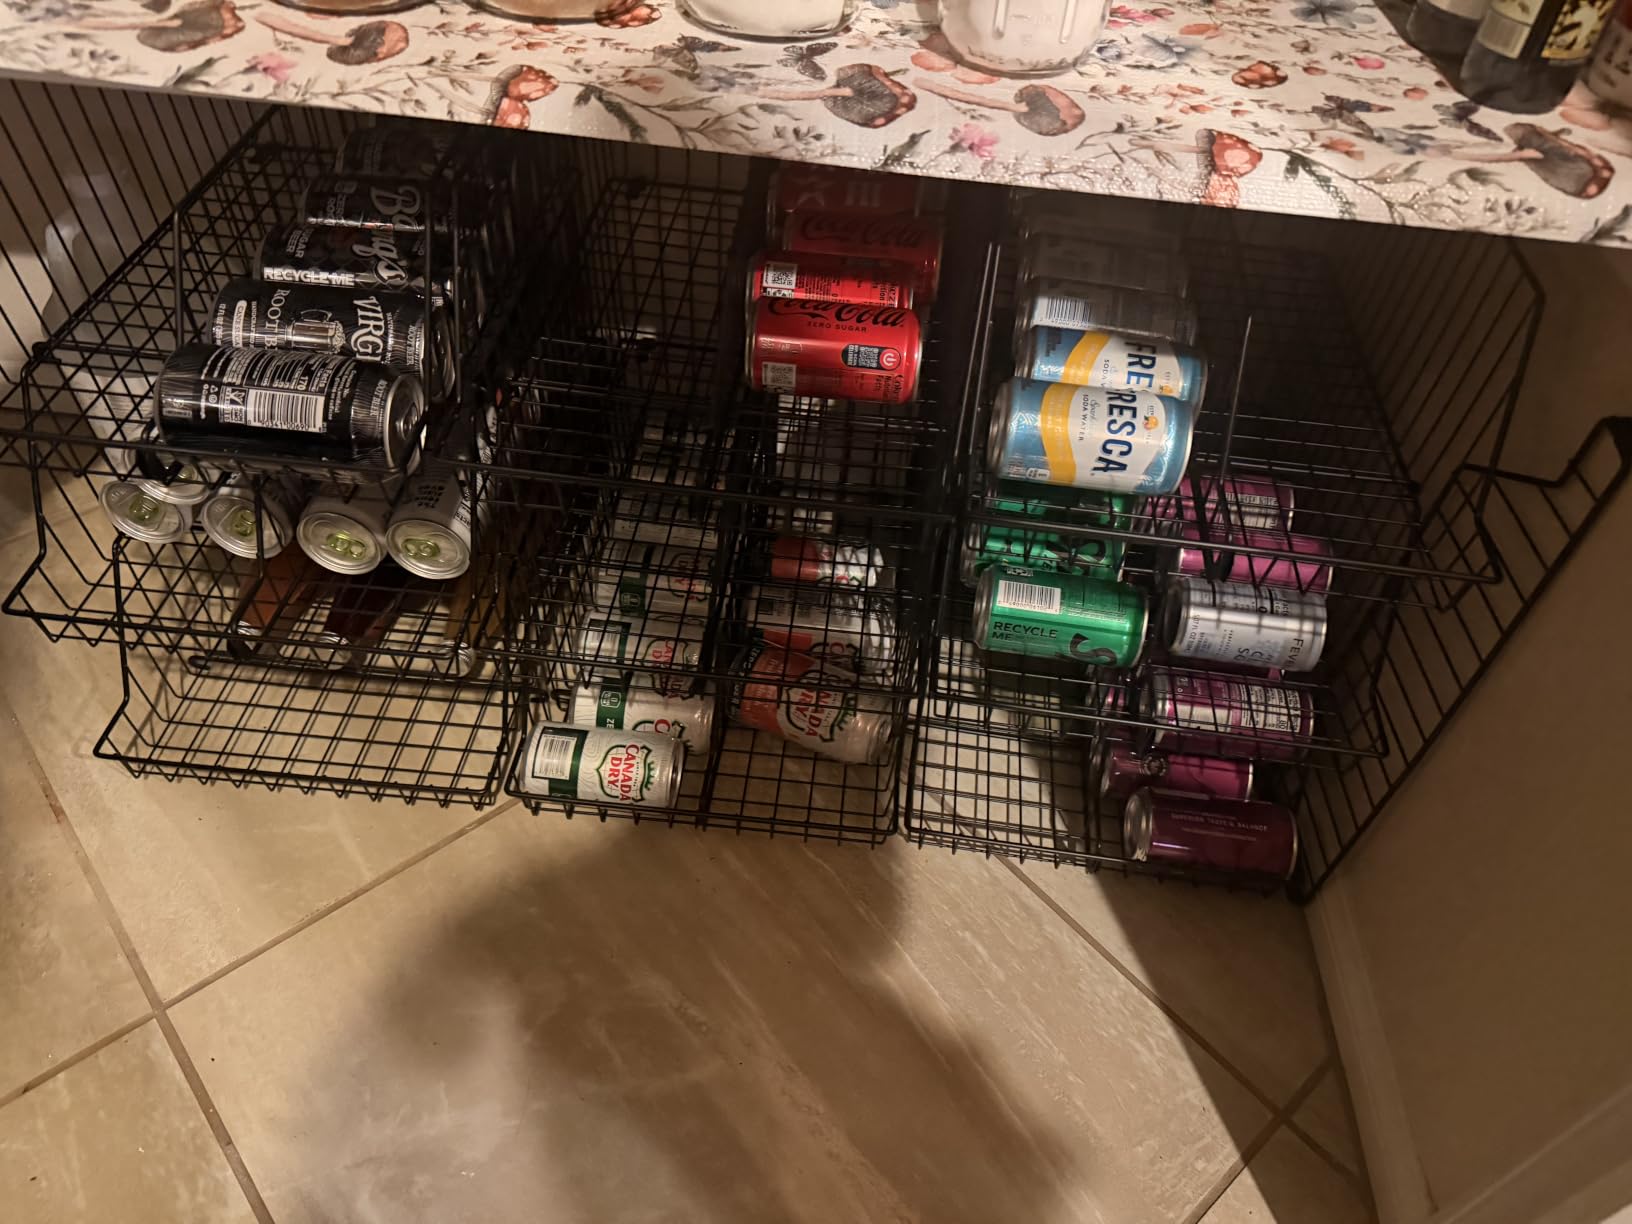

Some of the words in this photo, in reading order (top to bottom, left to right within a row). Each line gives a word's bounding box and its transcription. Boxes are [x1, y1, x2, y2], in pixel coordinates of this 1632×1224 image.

[263, 267, 331, 285] RECYCLE
[332, 272, 355, 287] ME
[265, 288, 291, 333] ROOT
[350, 295, 386, 362] VIRGI
[807, 321, 832, 330] ZERO
[836, 324, 867, 334] SUGAR
[1102, 359, 1110, 380] SODA
[1125, 341, 1156, 388] FRE
[297, 375, 309, 391] 170
[1078, 415, 1088, 440] WATER
[1092, 391, 1137, 473] RESCA
[991, 632, 1011, 640] ME
[993, 621, 1059, 639] RECYCLE
[1278, 719, 1287, 730] 80
[607, 756, 622, 788] DRY
[619, 744, 640, 802] CANADA
